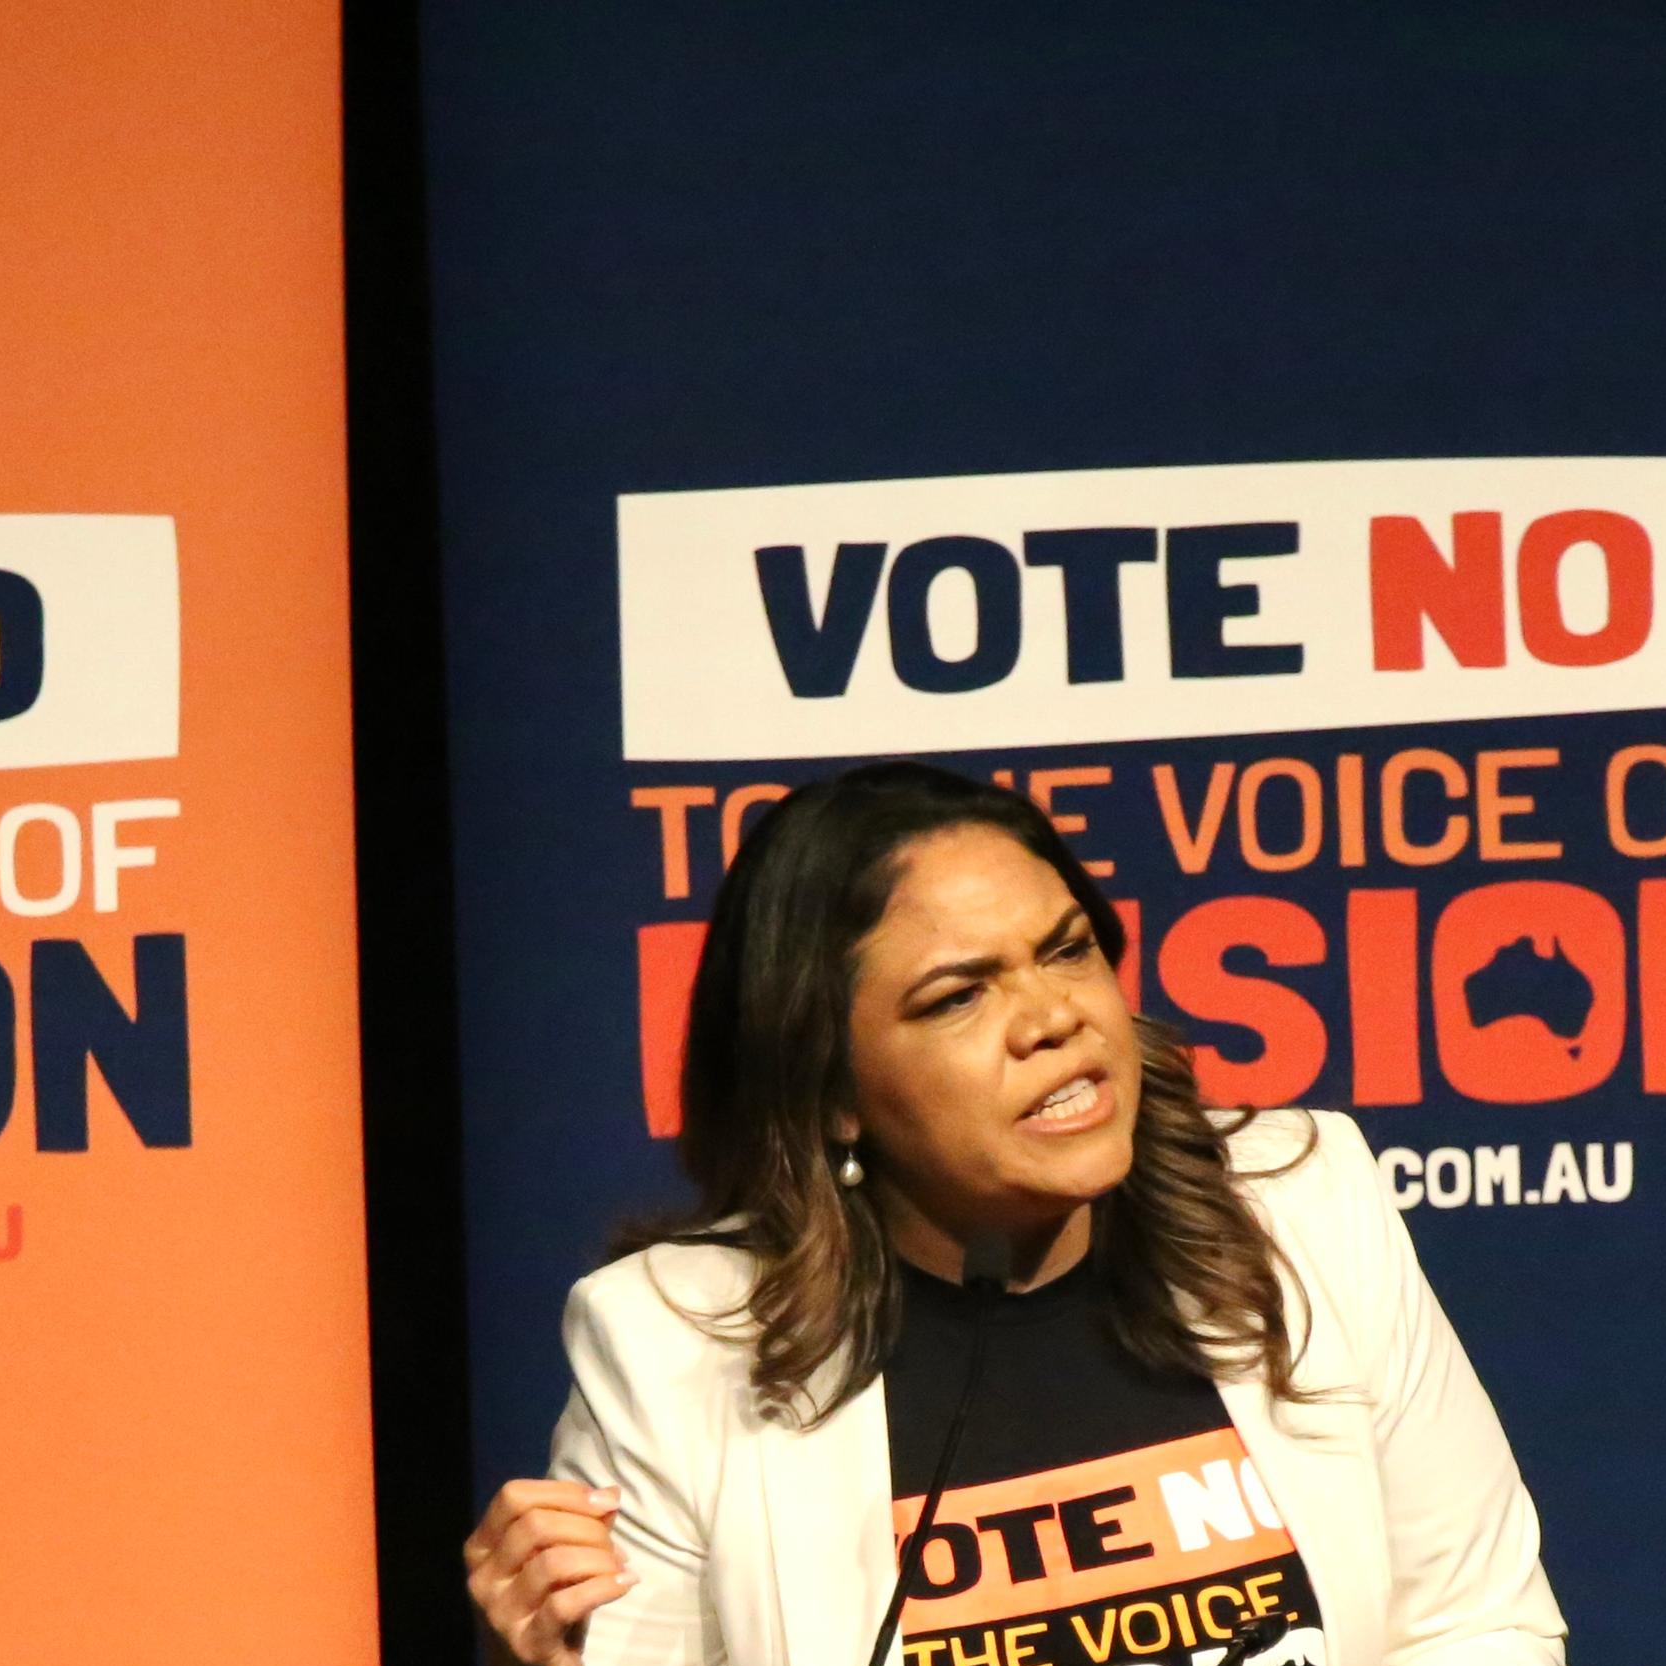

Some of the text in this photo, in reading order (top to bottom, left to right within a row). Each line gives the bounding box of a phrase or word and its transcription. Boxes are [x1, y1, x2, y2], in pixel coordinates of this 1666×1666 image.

[754, 509, 1654, 698] VOTE NO
[1152, 748, 1563, 874] VOICE
[895, 1485, 1154, 1600] OTE
[1071, 1572, 1299, 1664] VOICE
